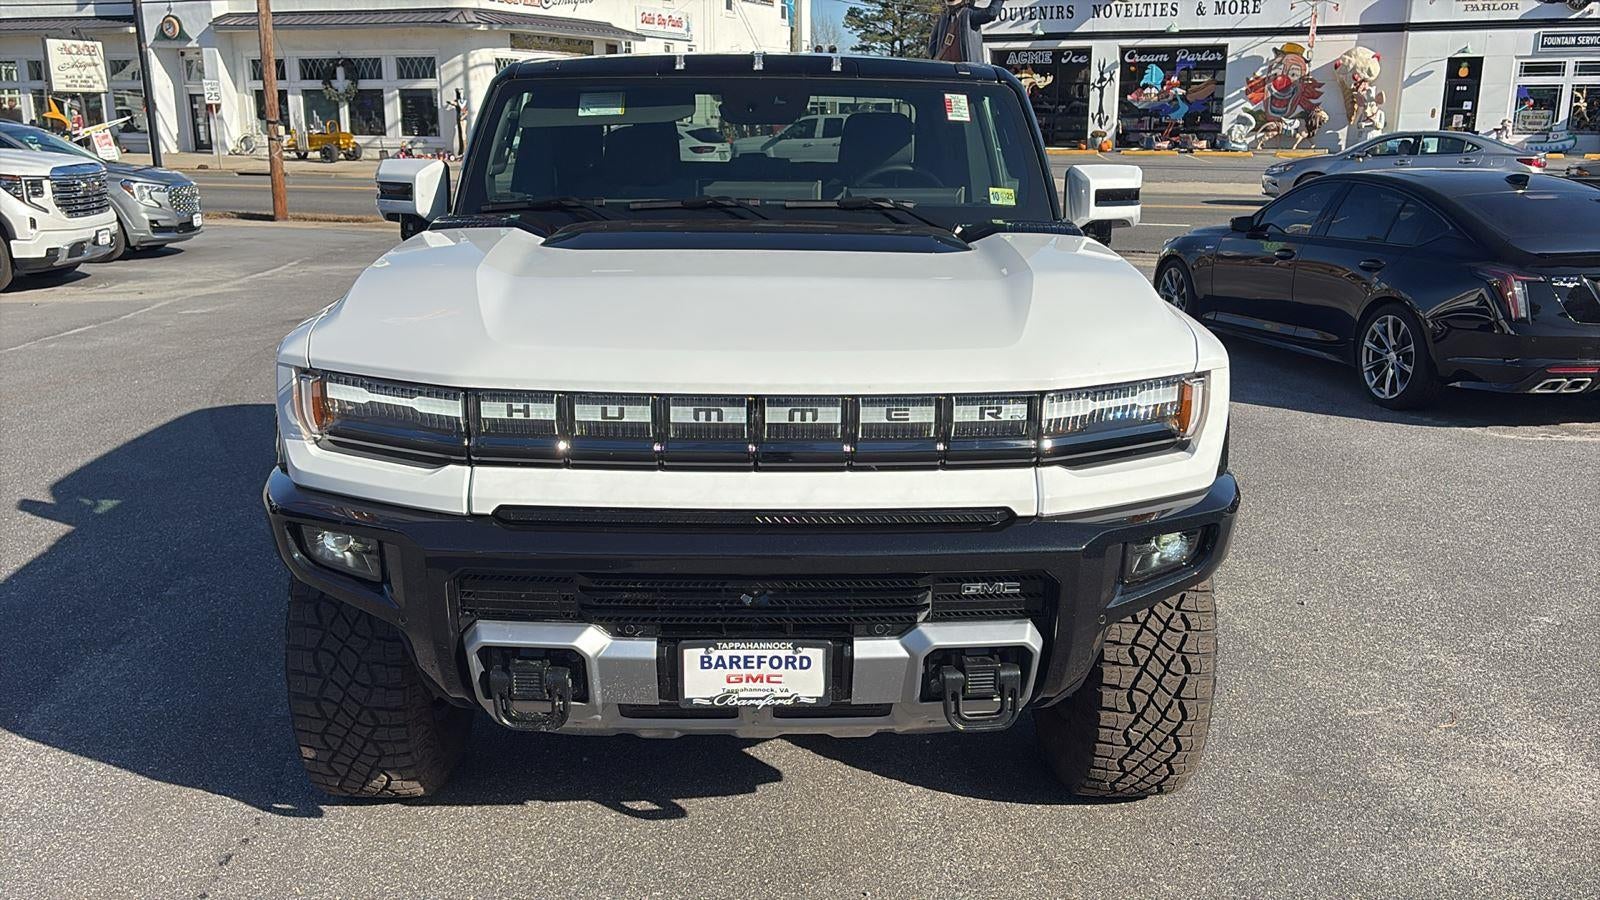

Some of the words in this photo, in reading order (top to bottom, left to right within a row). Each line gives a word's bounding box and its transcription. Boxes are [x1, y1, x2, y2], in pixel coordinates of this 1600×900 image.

[992, 4, 1075, 21] OUVENIRS
[1091, 2, 1179, 19] NOVELTIES
[1195, 2, 1207, 16] &
[1213, 0, 1262, 15] MORE
[1463, 2, 1519, 12] PARLOR
[641, 11, 655, 25] Dutch
[657, 13, 667, 29] Boy
[667, 14, 683, 28] Paints
[1543, 36, 1576, 46] FOUNTAIN
[1006, 50, 1053, 65] ACME
[1061, 50, 1089, 64] Ice
[1124, 49, 1170, 63] Cream
[1175, 48, 1224, 62] Parlor
[206, 92, 221, 101] 25
[991, 191, 1000, 201] 10
[1006, 192, 1014, 200] 25
[961, 582, 1020, 595] GMC
[716, 642, 794, 650] TAPPAHANNOCK
[699, 655, 812, 670] BAREFORD
[725, 673, 783, 684] GMC
[714, 693, 799, 710] Bareford
